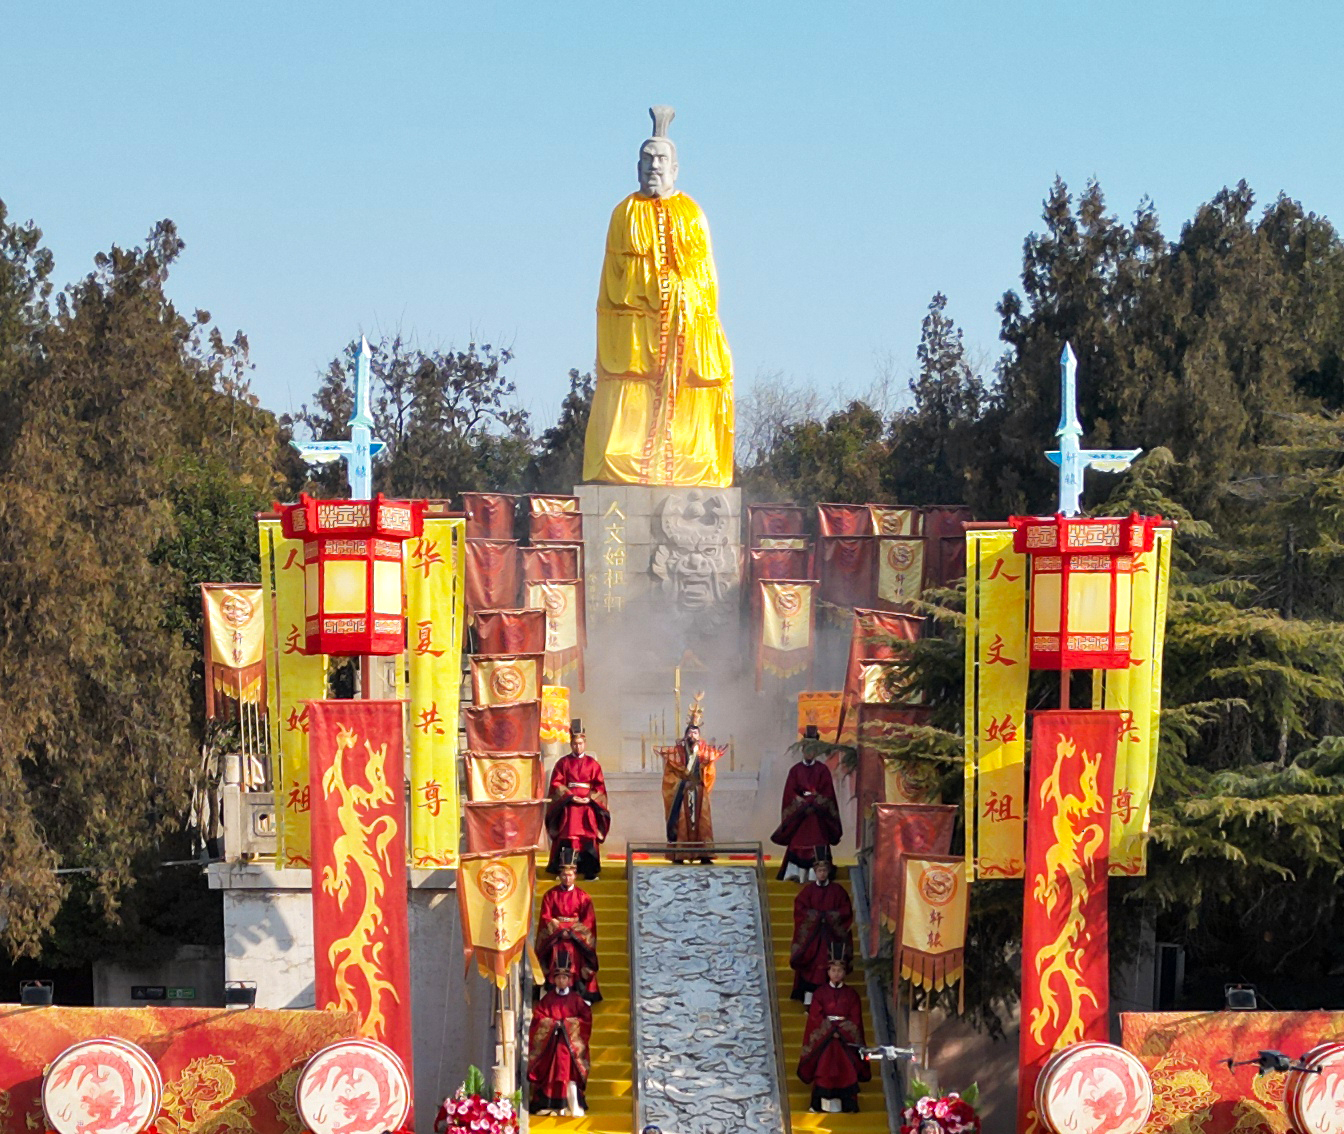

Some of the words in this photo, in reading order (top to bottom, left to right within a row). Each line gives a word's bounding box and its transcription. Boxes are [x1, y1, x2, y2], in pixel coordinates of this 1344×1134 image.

[282, 547, 311, 814] 人文始祖
[411, 537, 448, 818] 华夏共尊
[982, 558, 1022, 824] 人文始祖
